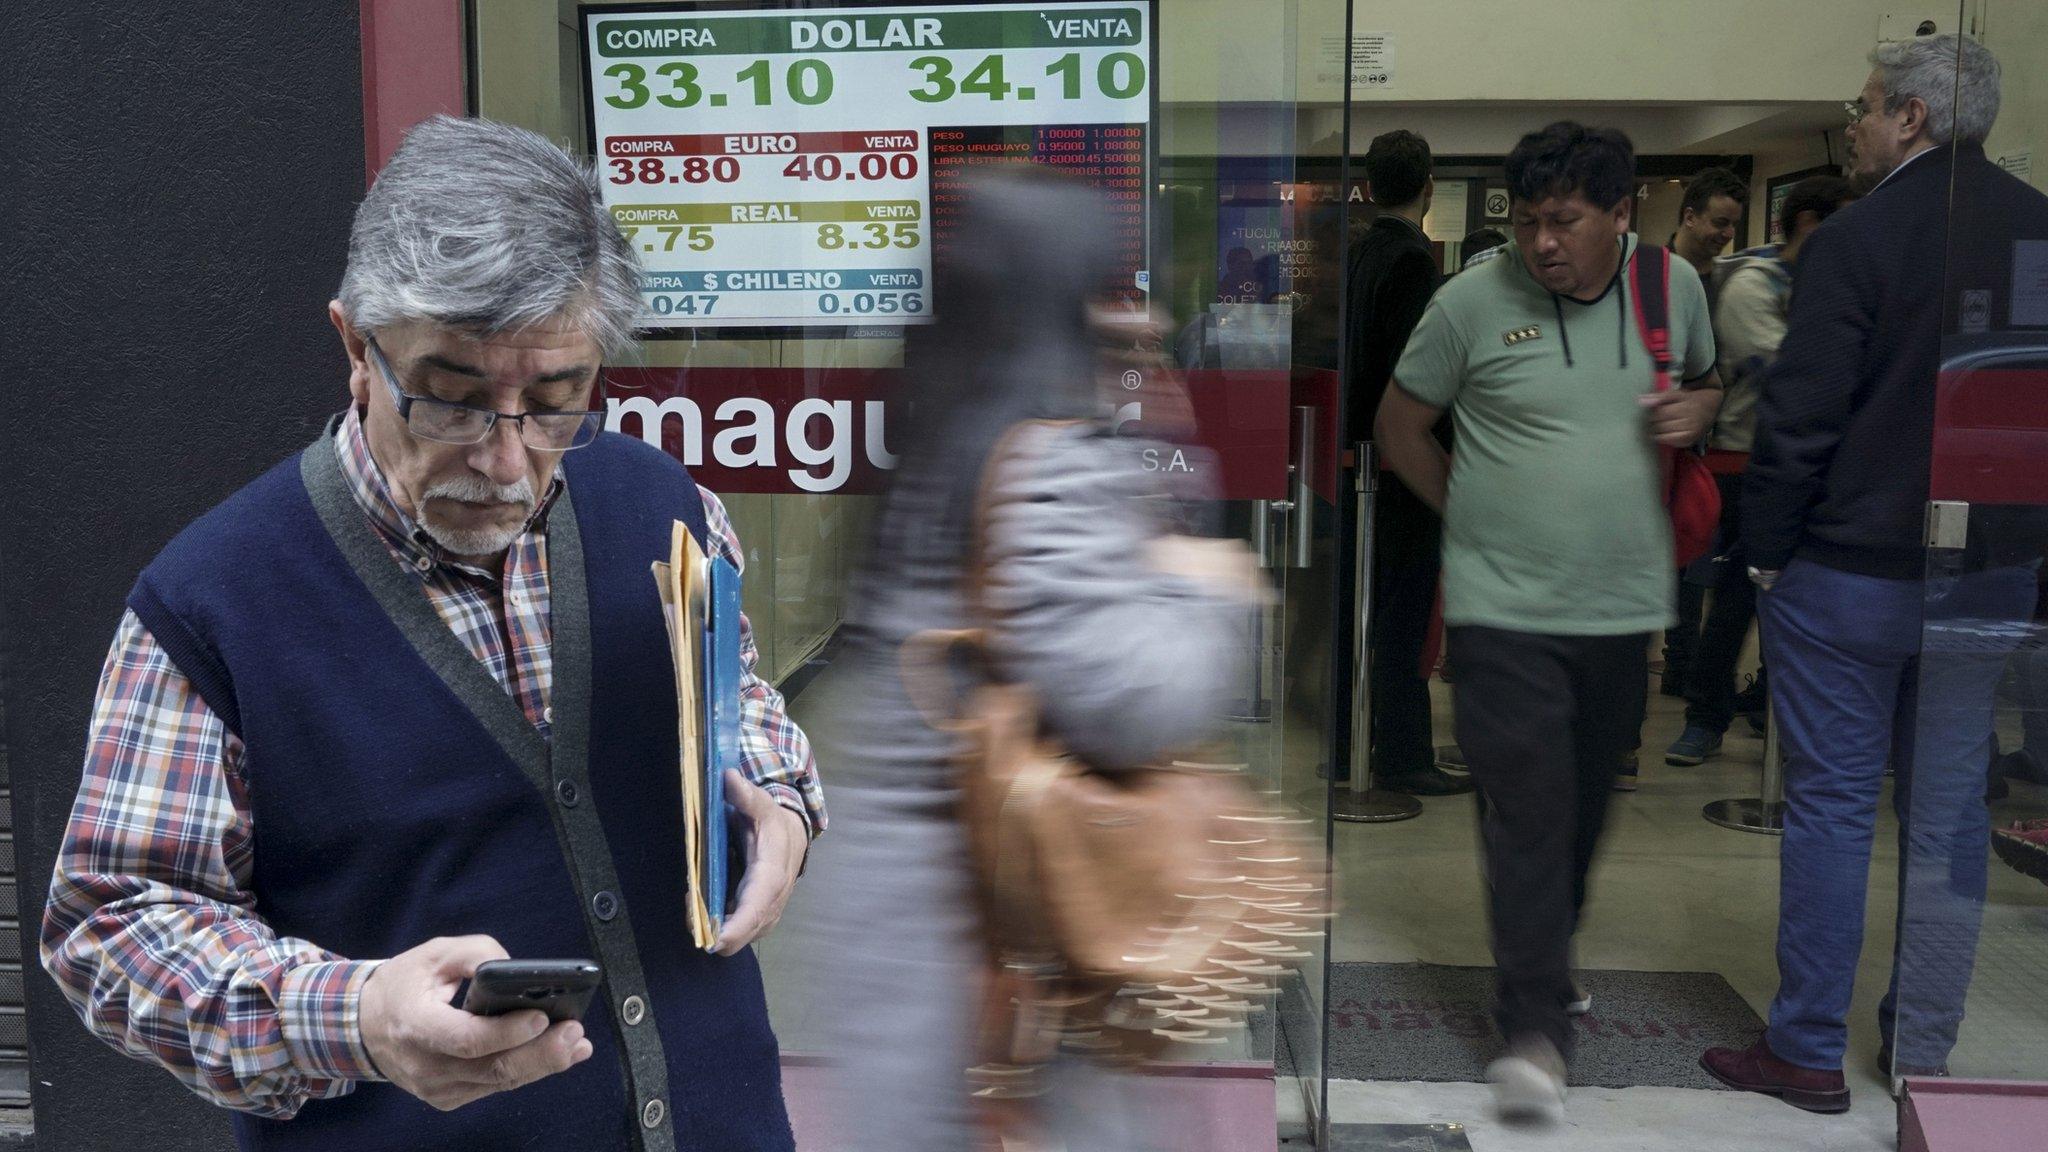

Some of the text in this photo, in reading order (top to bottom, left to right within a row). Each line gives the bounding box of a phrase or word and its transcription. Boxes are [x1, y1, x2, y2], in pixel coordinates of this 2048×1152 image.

[606, 18, 1132, 49] COMPRA DOLAR VENTA
[603, 52, 1146, 109] 33.10 34.10
[933, 128, 1141, 140] PESO 1.00000 1.00000
[610, 135, 913, 154] COMPRA EURO VENTA
[933, 144, 964, 153] PESO
[967, 143, 1031, 152] URUGUAYO
[1038, 142, 1086, 151] 0.95000
[608, 152, 918, 185] 38.80 40.00
[934, 156, 965, 165] LIBRA
[615, 204, 916, 222] COMPRA REAL VENTA
[817, 222, 921, 250] 8.35
[703, 272, 719, 291] $
[726, 272, 841, 290] CHILENO
[869, 274, 918, 286] VENTA
[818, 292, 924, 314] 0.056
